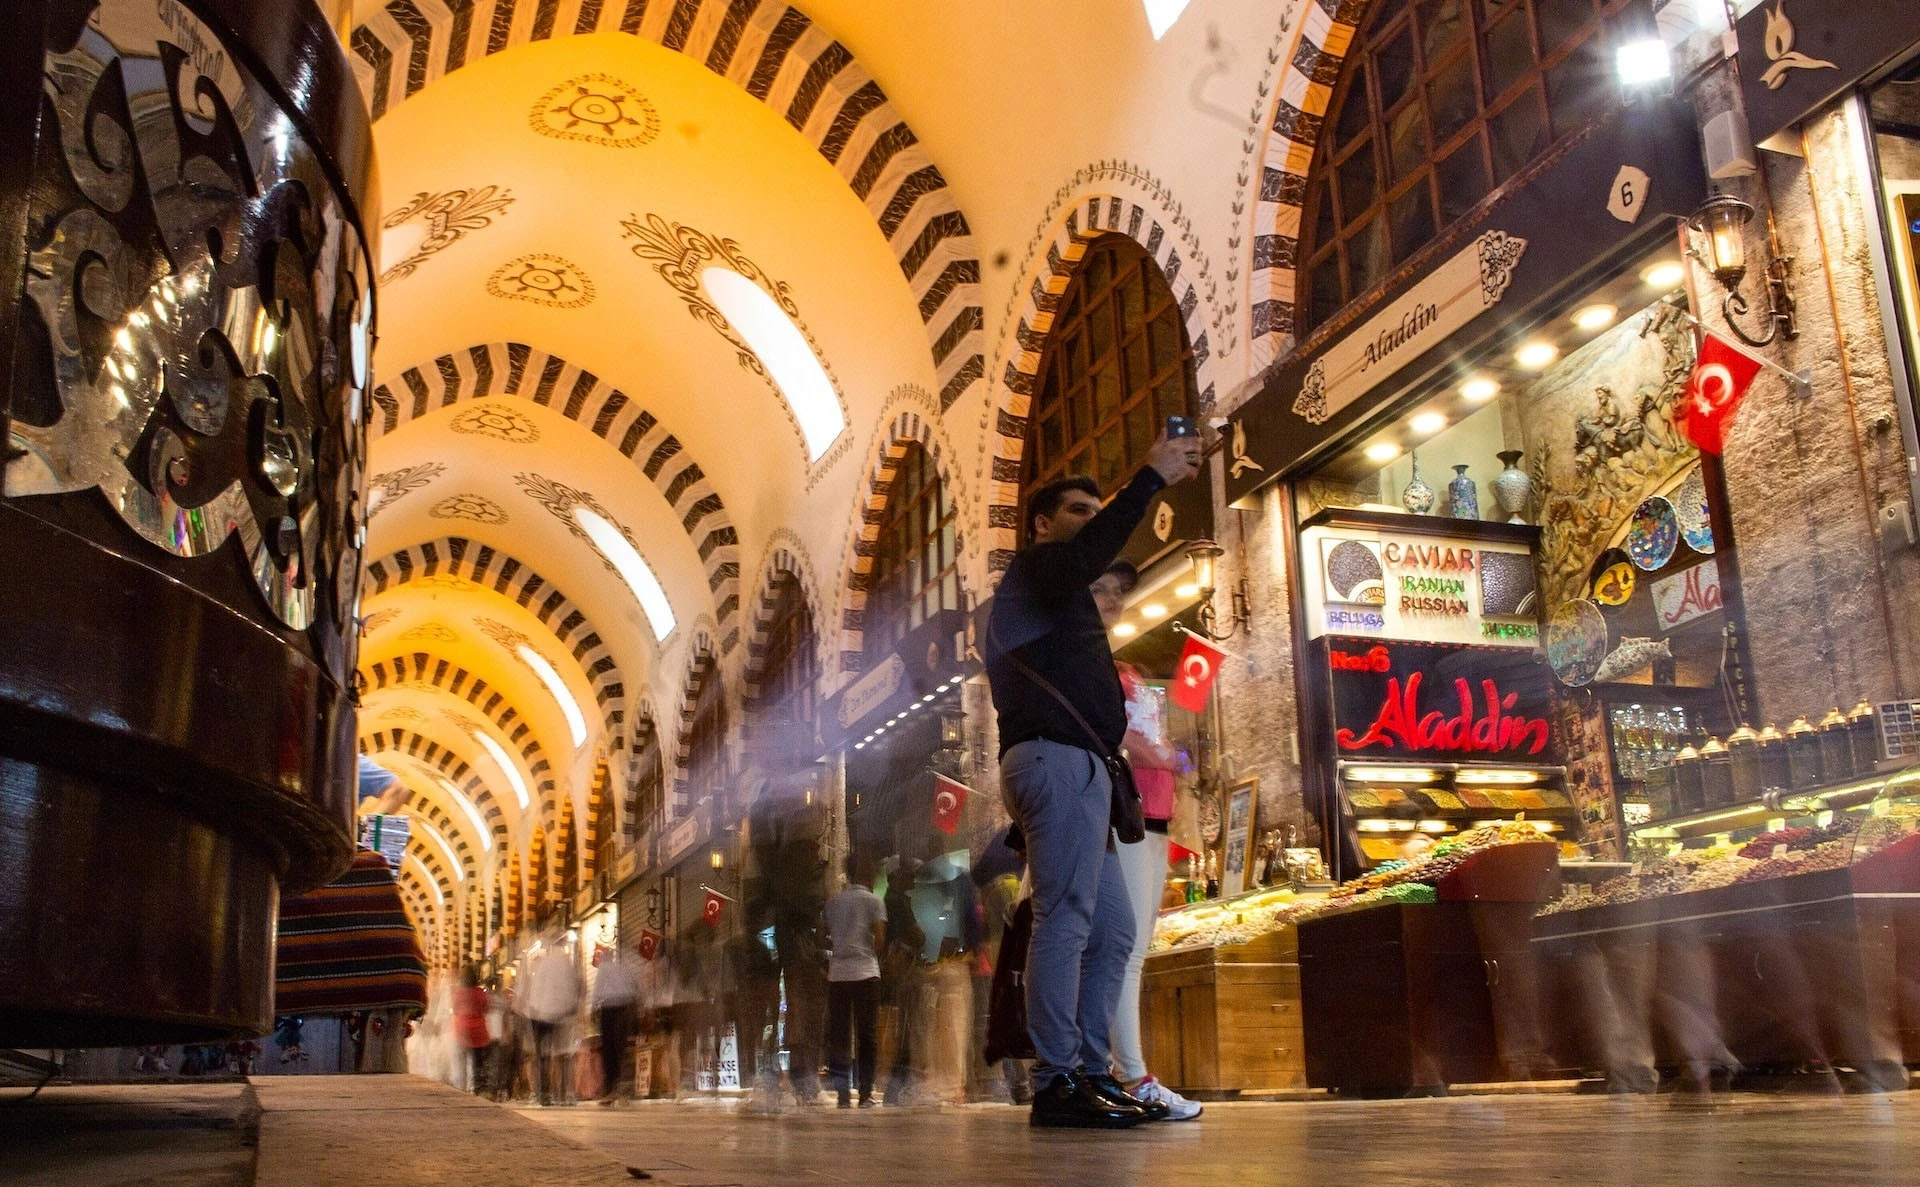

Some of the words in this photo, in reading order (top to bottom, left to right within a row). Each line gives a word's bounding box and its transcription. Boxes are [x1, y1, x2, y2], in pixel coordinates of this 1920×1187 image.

[1621, 181, 1634, 207] 6
[1361, 303, 1438, 372] Aladdin
[1384, 542, 1475, 570] CAVIAR
[1401, 575, 1465, 593] IRANIAN
[1329, 611, 1385, 626] BELUGA
[1401, 596, 1469, 614] RUSSIAN
[1728, 621, 1748, 712] SPICES
[1337, 671, 1550, 755] Aladdin
